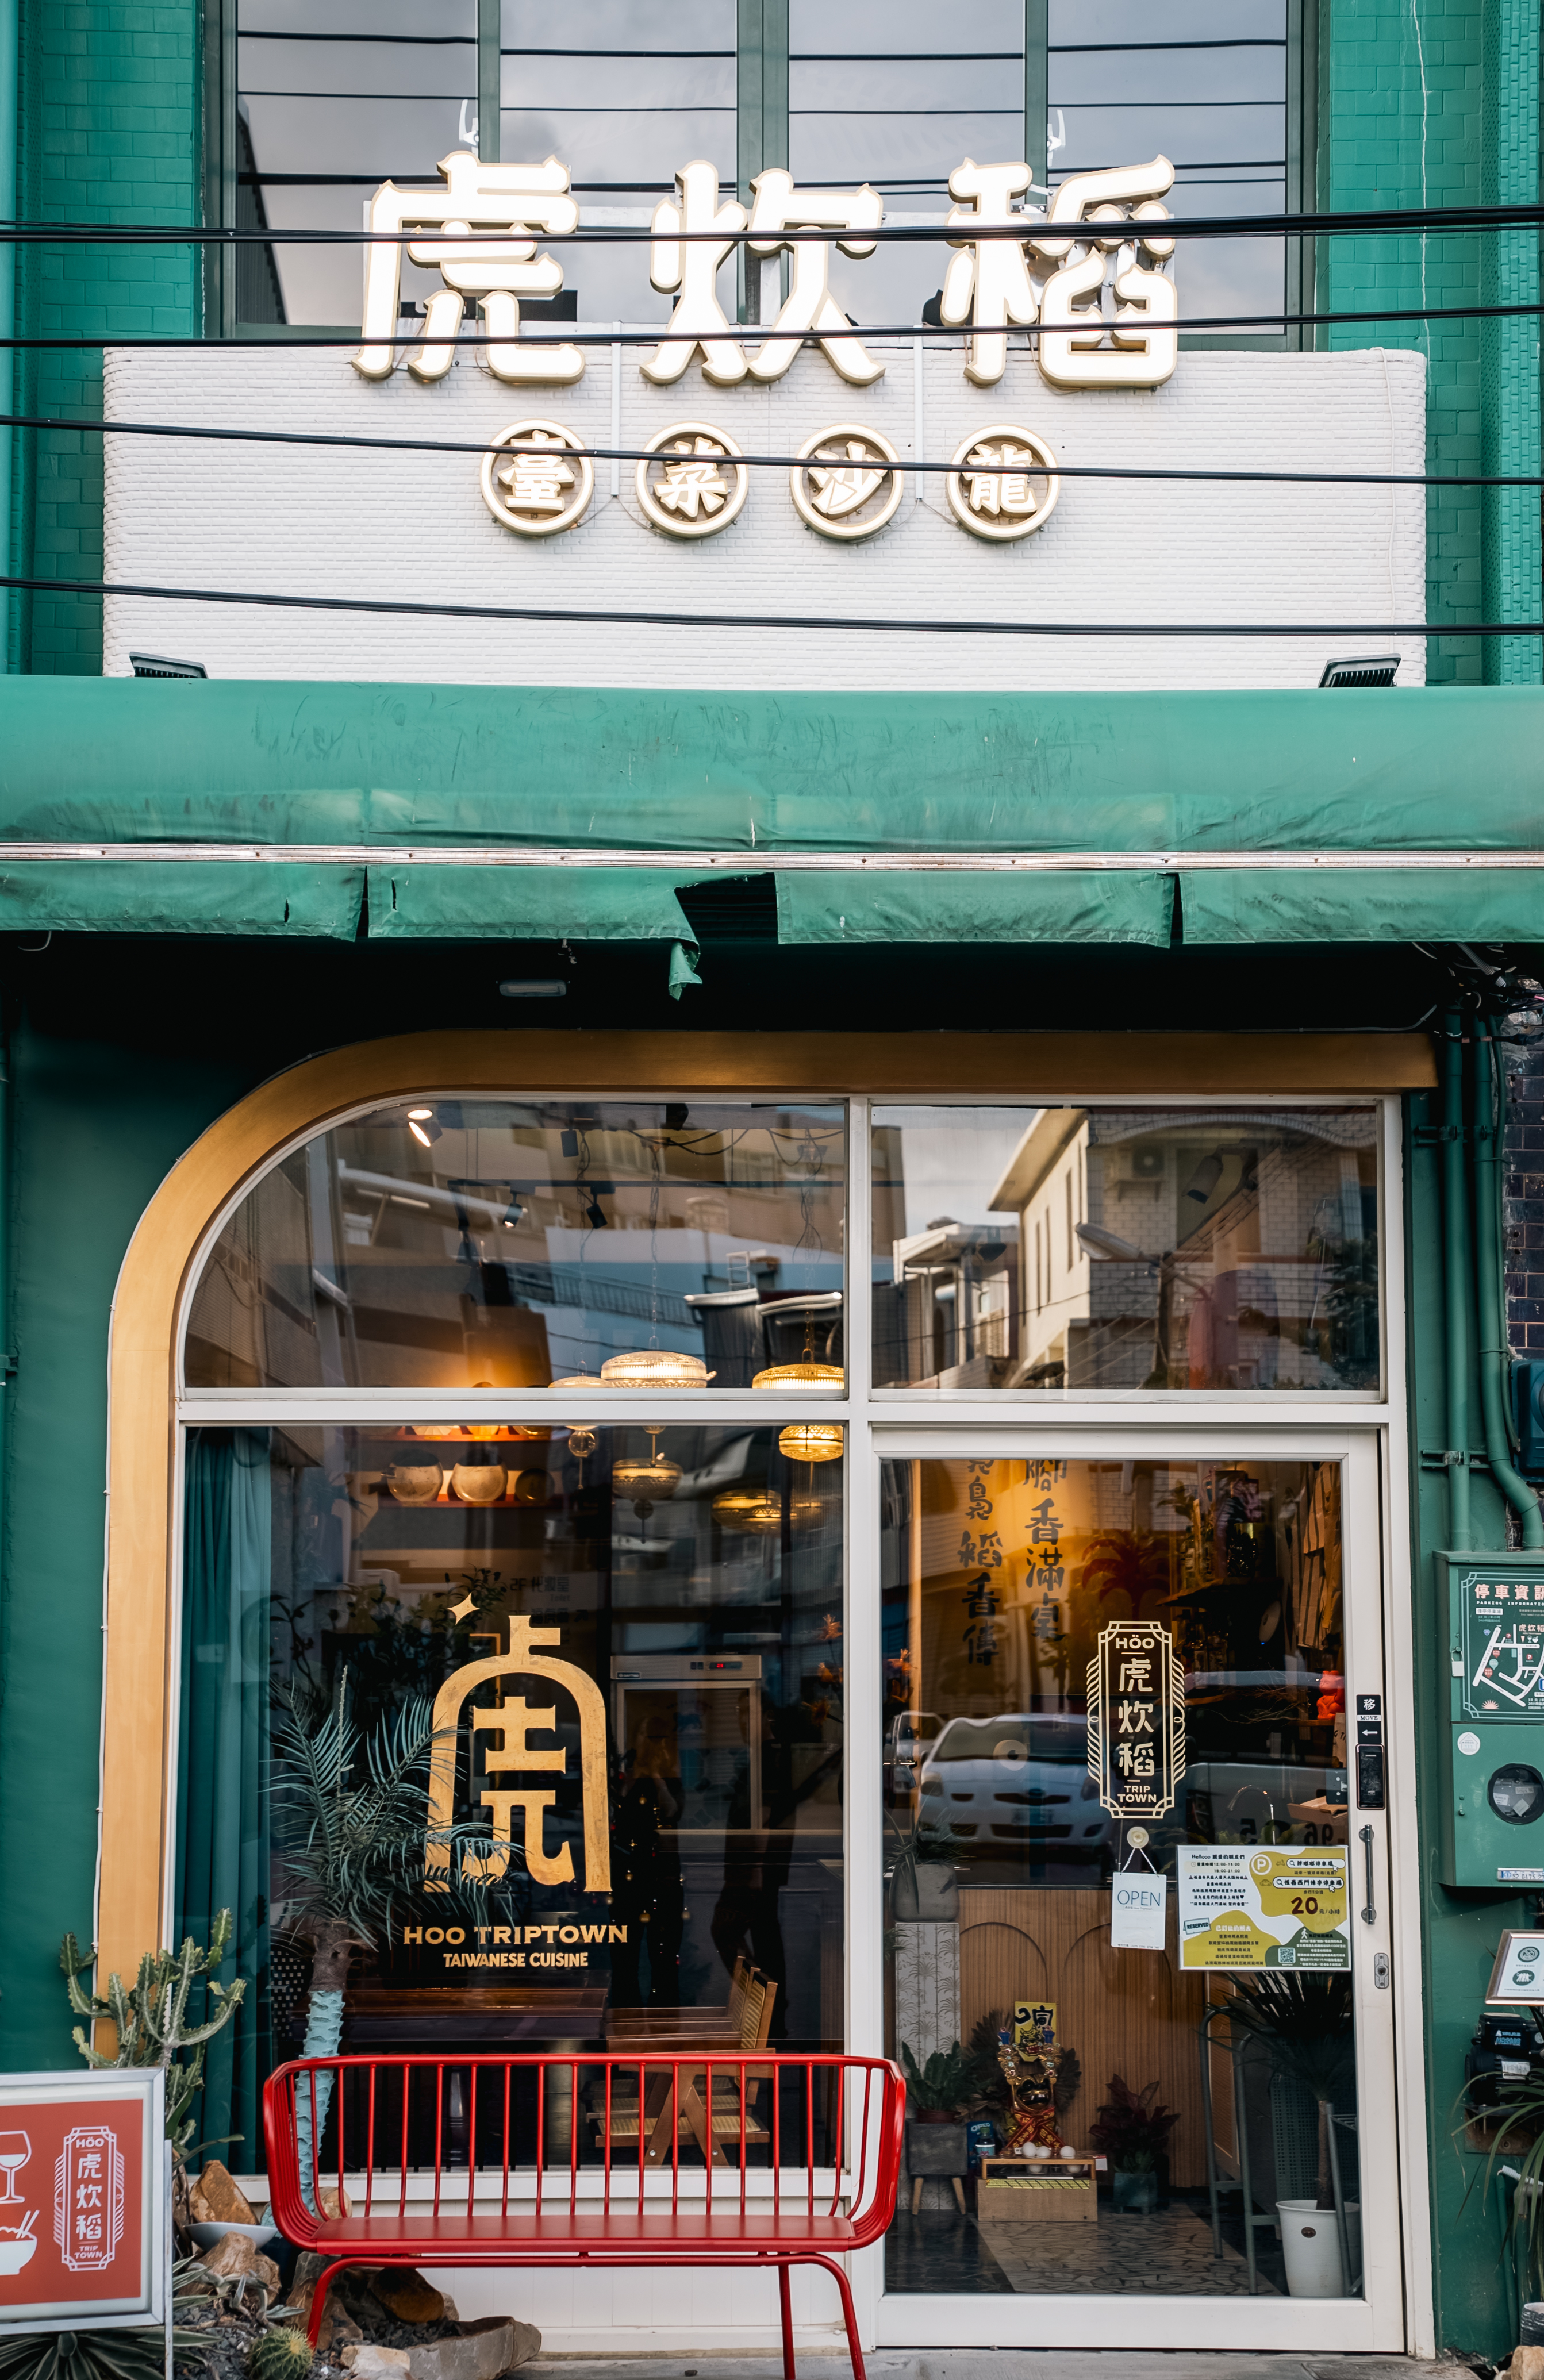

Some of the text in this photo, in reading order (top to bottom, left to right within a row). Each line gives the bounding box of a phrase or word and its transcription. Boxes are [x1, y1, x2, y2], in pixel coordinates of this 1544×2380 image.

[351, 151, 1178, 389] 虎炊稻
[494, 429, 1039, 520] 臺菜沙龍
[1363, 1698, 1376, 1710] 移
[1119, 1658, 1154, 1777] 虎炊稻
[1124, 1785, 1151, 1793] TRIP
[1117, 1794, 1157, 1803] TOWN
[1117, 1890, 1161, 1907] OPEN
[1290, 1897, 1318, 1915] 20
[403, 1924, 628, 1944] HOO TRIPTOWN
[443, 1952, 589, 1968] TAIWANESE CUISINE
[75, 2153, 102, 2240] 虎炊稻
[74, 2251, 103, 2259] TOWN
